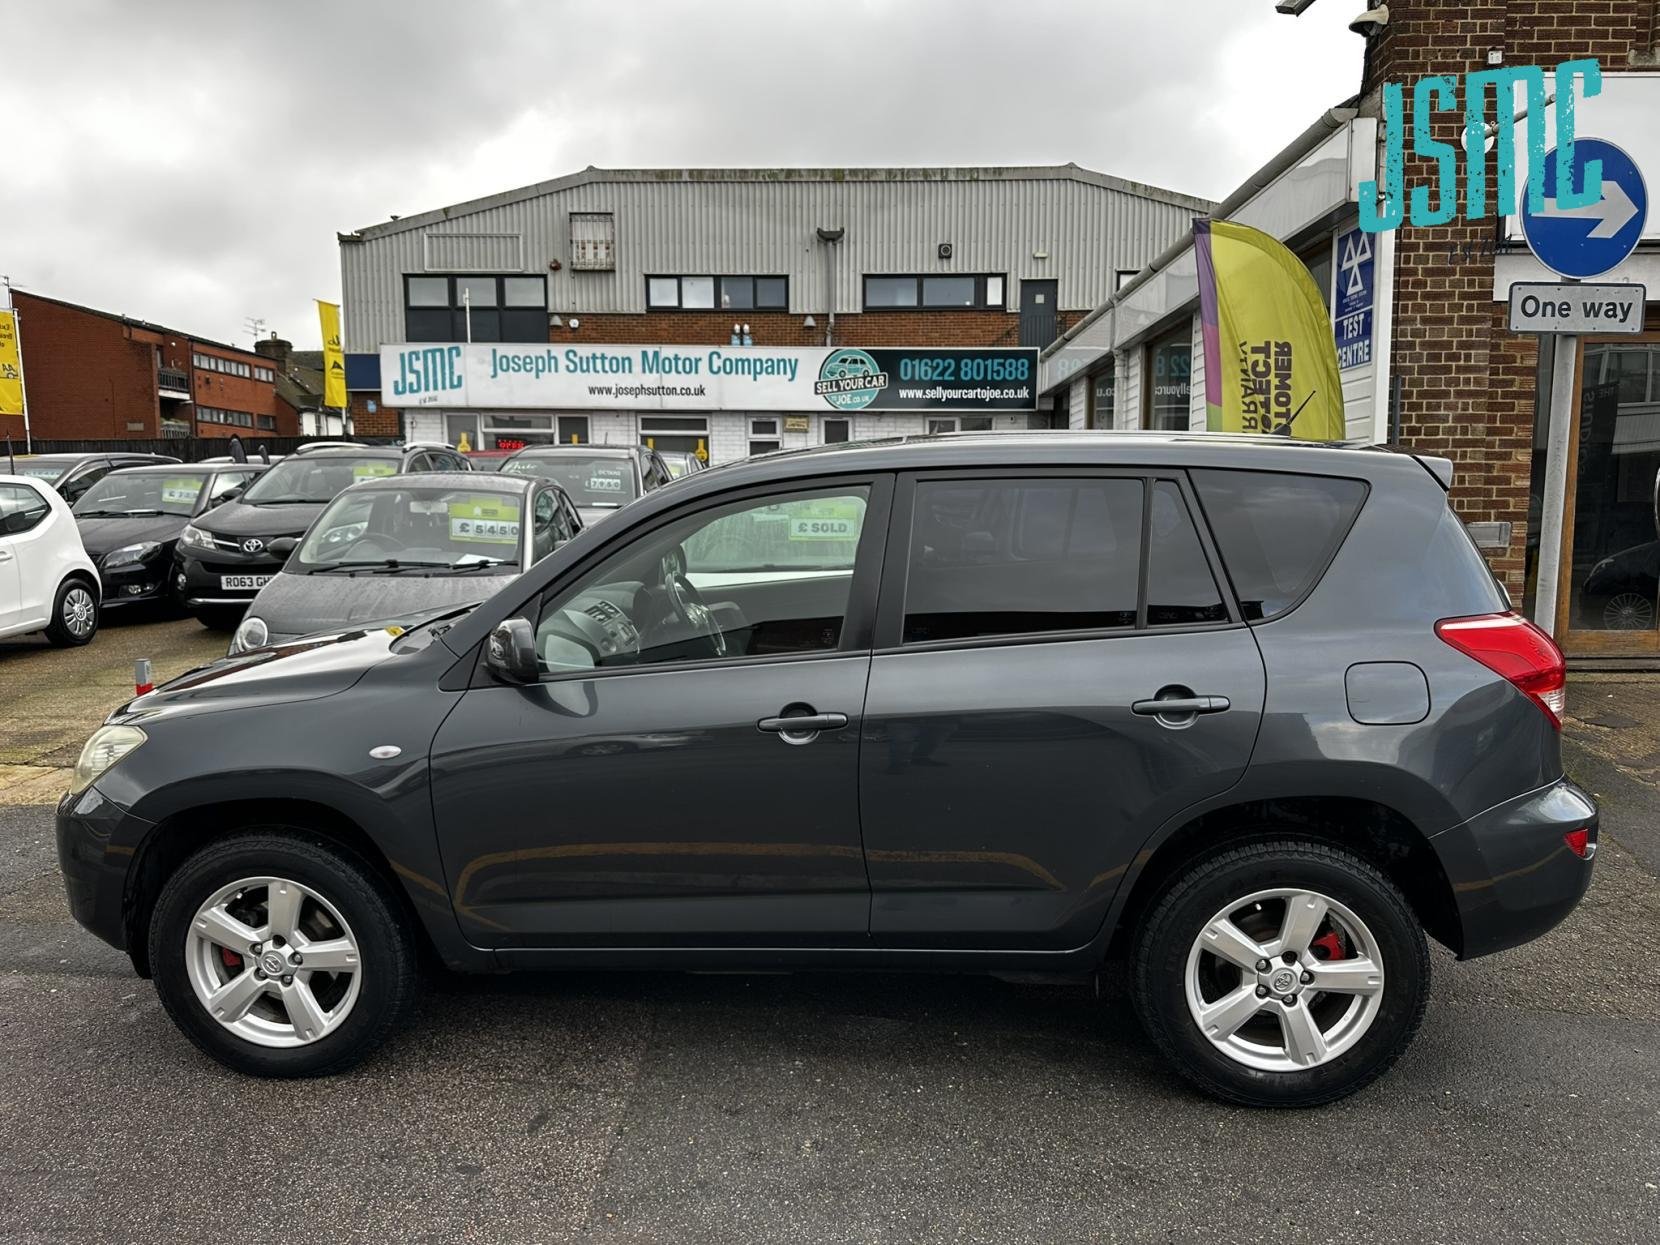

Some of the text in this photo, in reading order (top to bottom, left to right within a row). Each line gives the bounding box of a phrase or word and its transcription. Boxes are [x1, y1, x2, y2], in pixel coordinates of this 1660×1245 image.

[1520, 295, 1634, 323] One way
[1343, 313, 1365, 340] TEST
[490, 349, 799, 382] Joseph Sutton Motor Company
[1337, 339, 1370, 369] CENTRE
[393, 346, 463, 396] JSMC
[899, 358, 1029, 381] 01622 801588
[588, 384, 706, 398] www.josephsutton.co.uk
[816, 375, 885, 394] SELL YOUR CAR
[899, 386, 1029, 401] www.sellyourcartojoe.co.uk
[811, 522, 848, 533] SOLD
